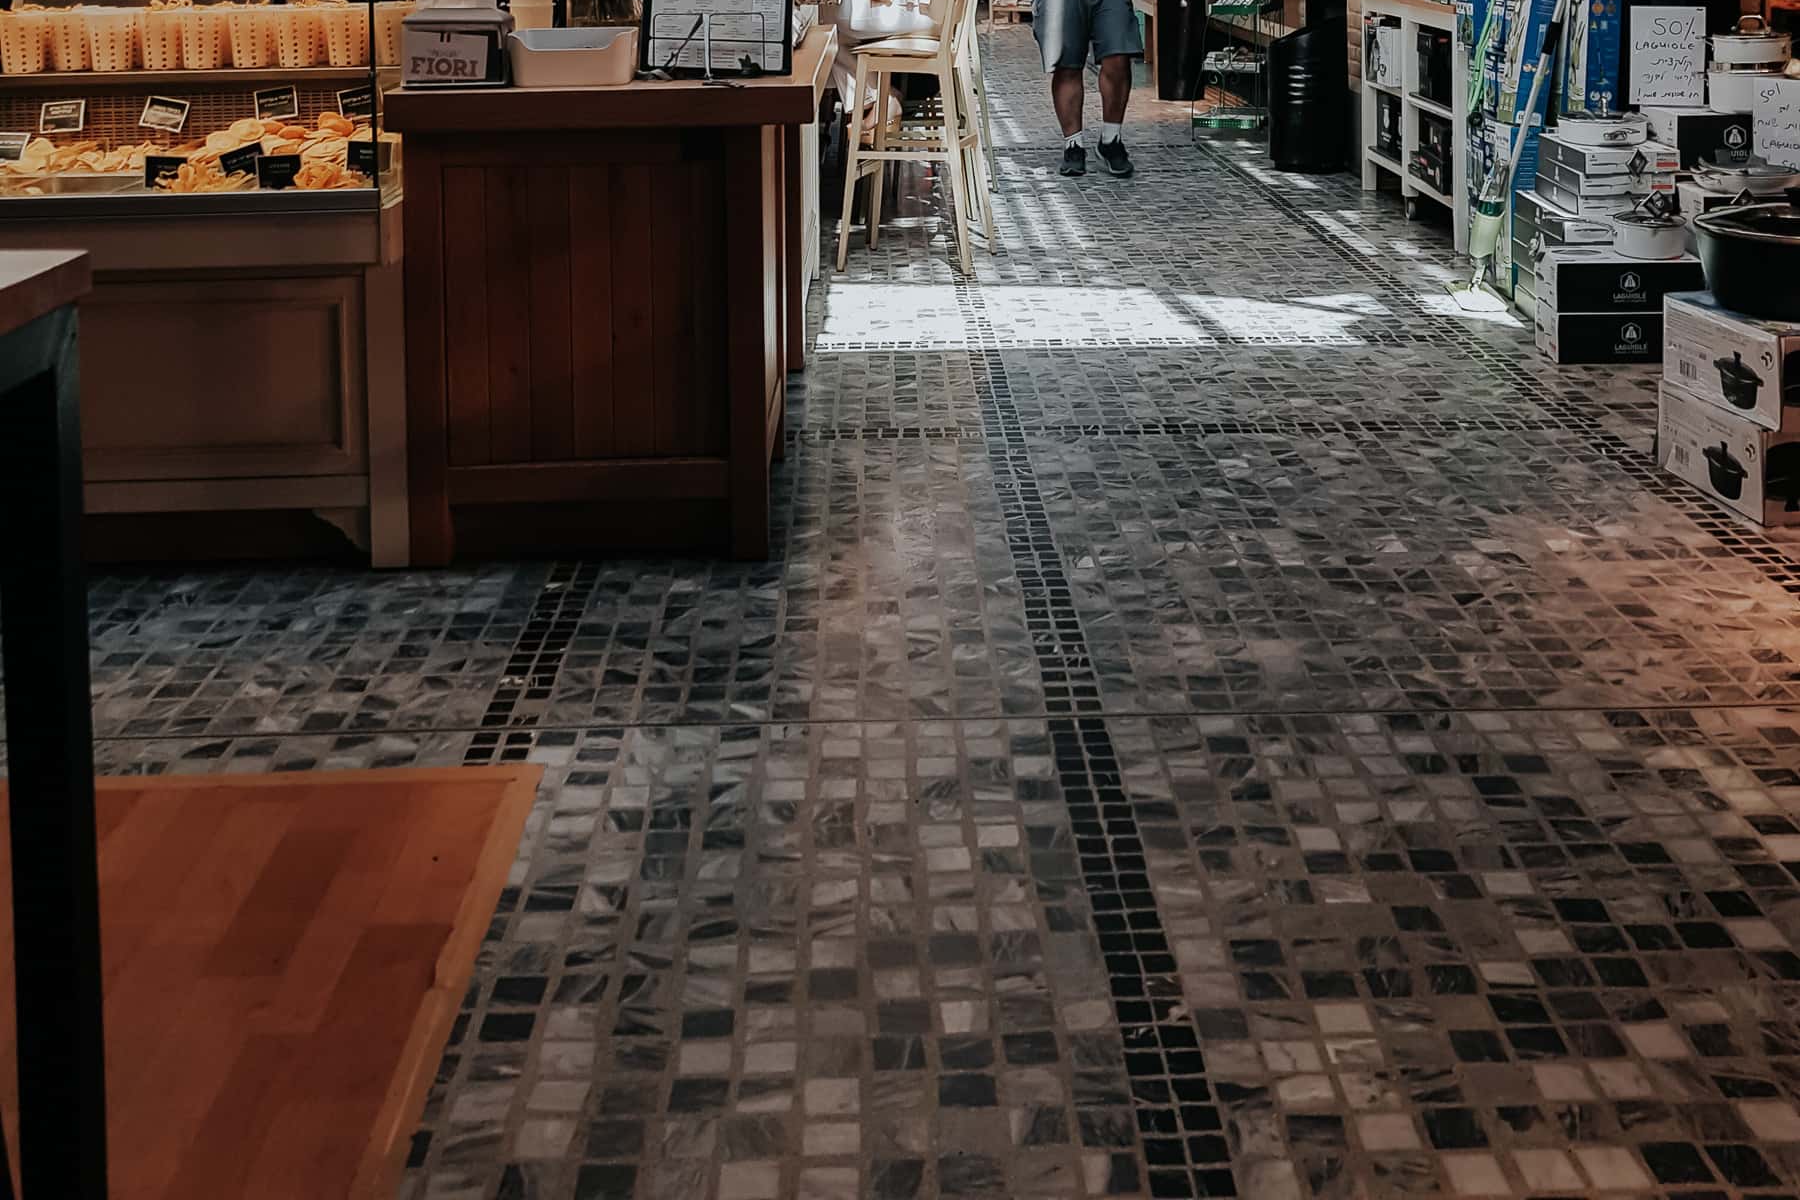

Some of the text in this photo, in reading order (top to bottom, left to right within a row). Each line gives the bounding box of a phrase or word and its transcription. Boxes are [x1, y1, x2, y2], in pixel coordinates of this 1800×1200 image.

[1652, 17, 1695, 41] 50%
[1635, 40, 1696, 51] LAGUIOLE
[411, 56, 479, 77] FIORI
